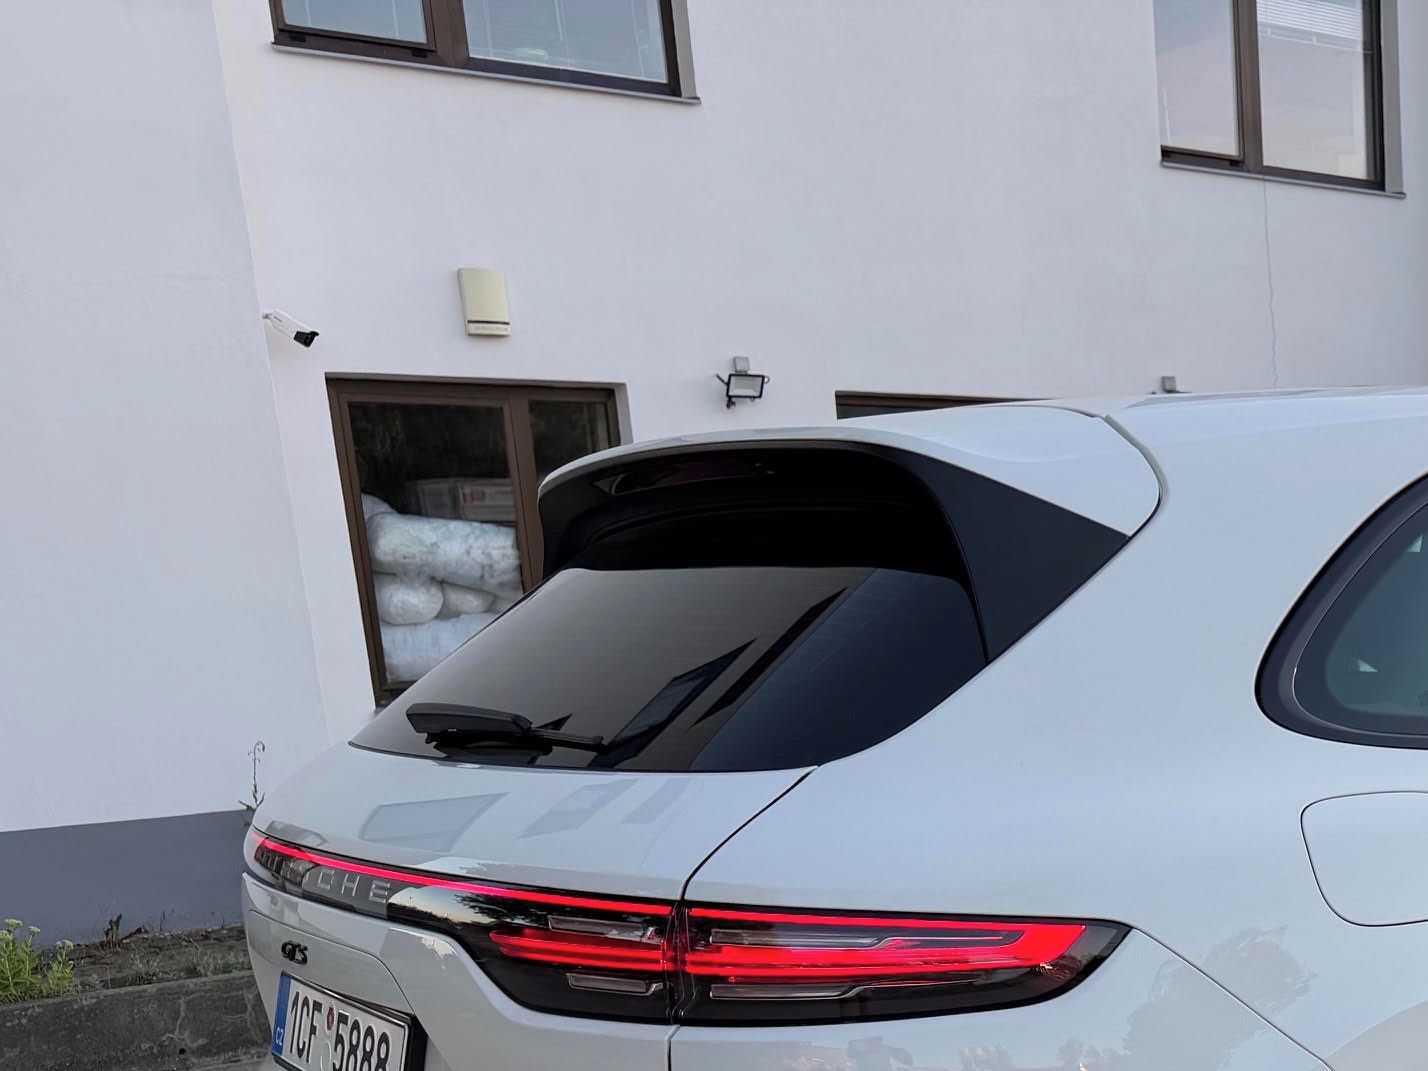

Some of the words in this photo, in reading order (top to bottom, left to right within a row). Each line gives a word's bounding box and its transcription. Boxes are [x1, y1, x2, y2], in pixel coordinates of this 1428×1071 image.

[281, 940, 309, 965] GTS
[275, 1027, 284, 1047] CZ
[289, 990, 323, 1064] 1CF
